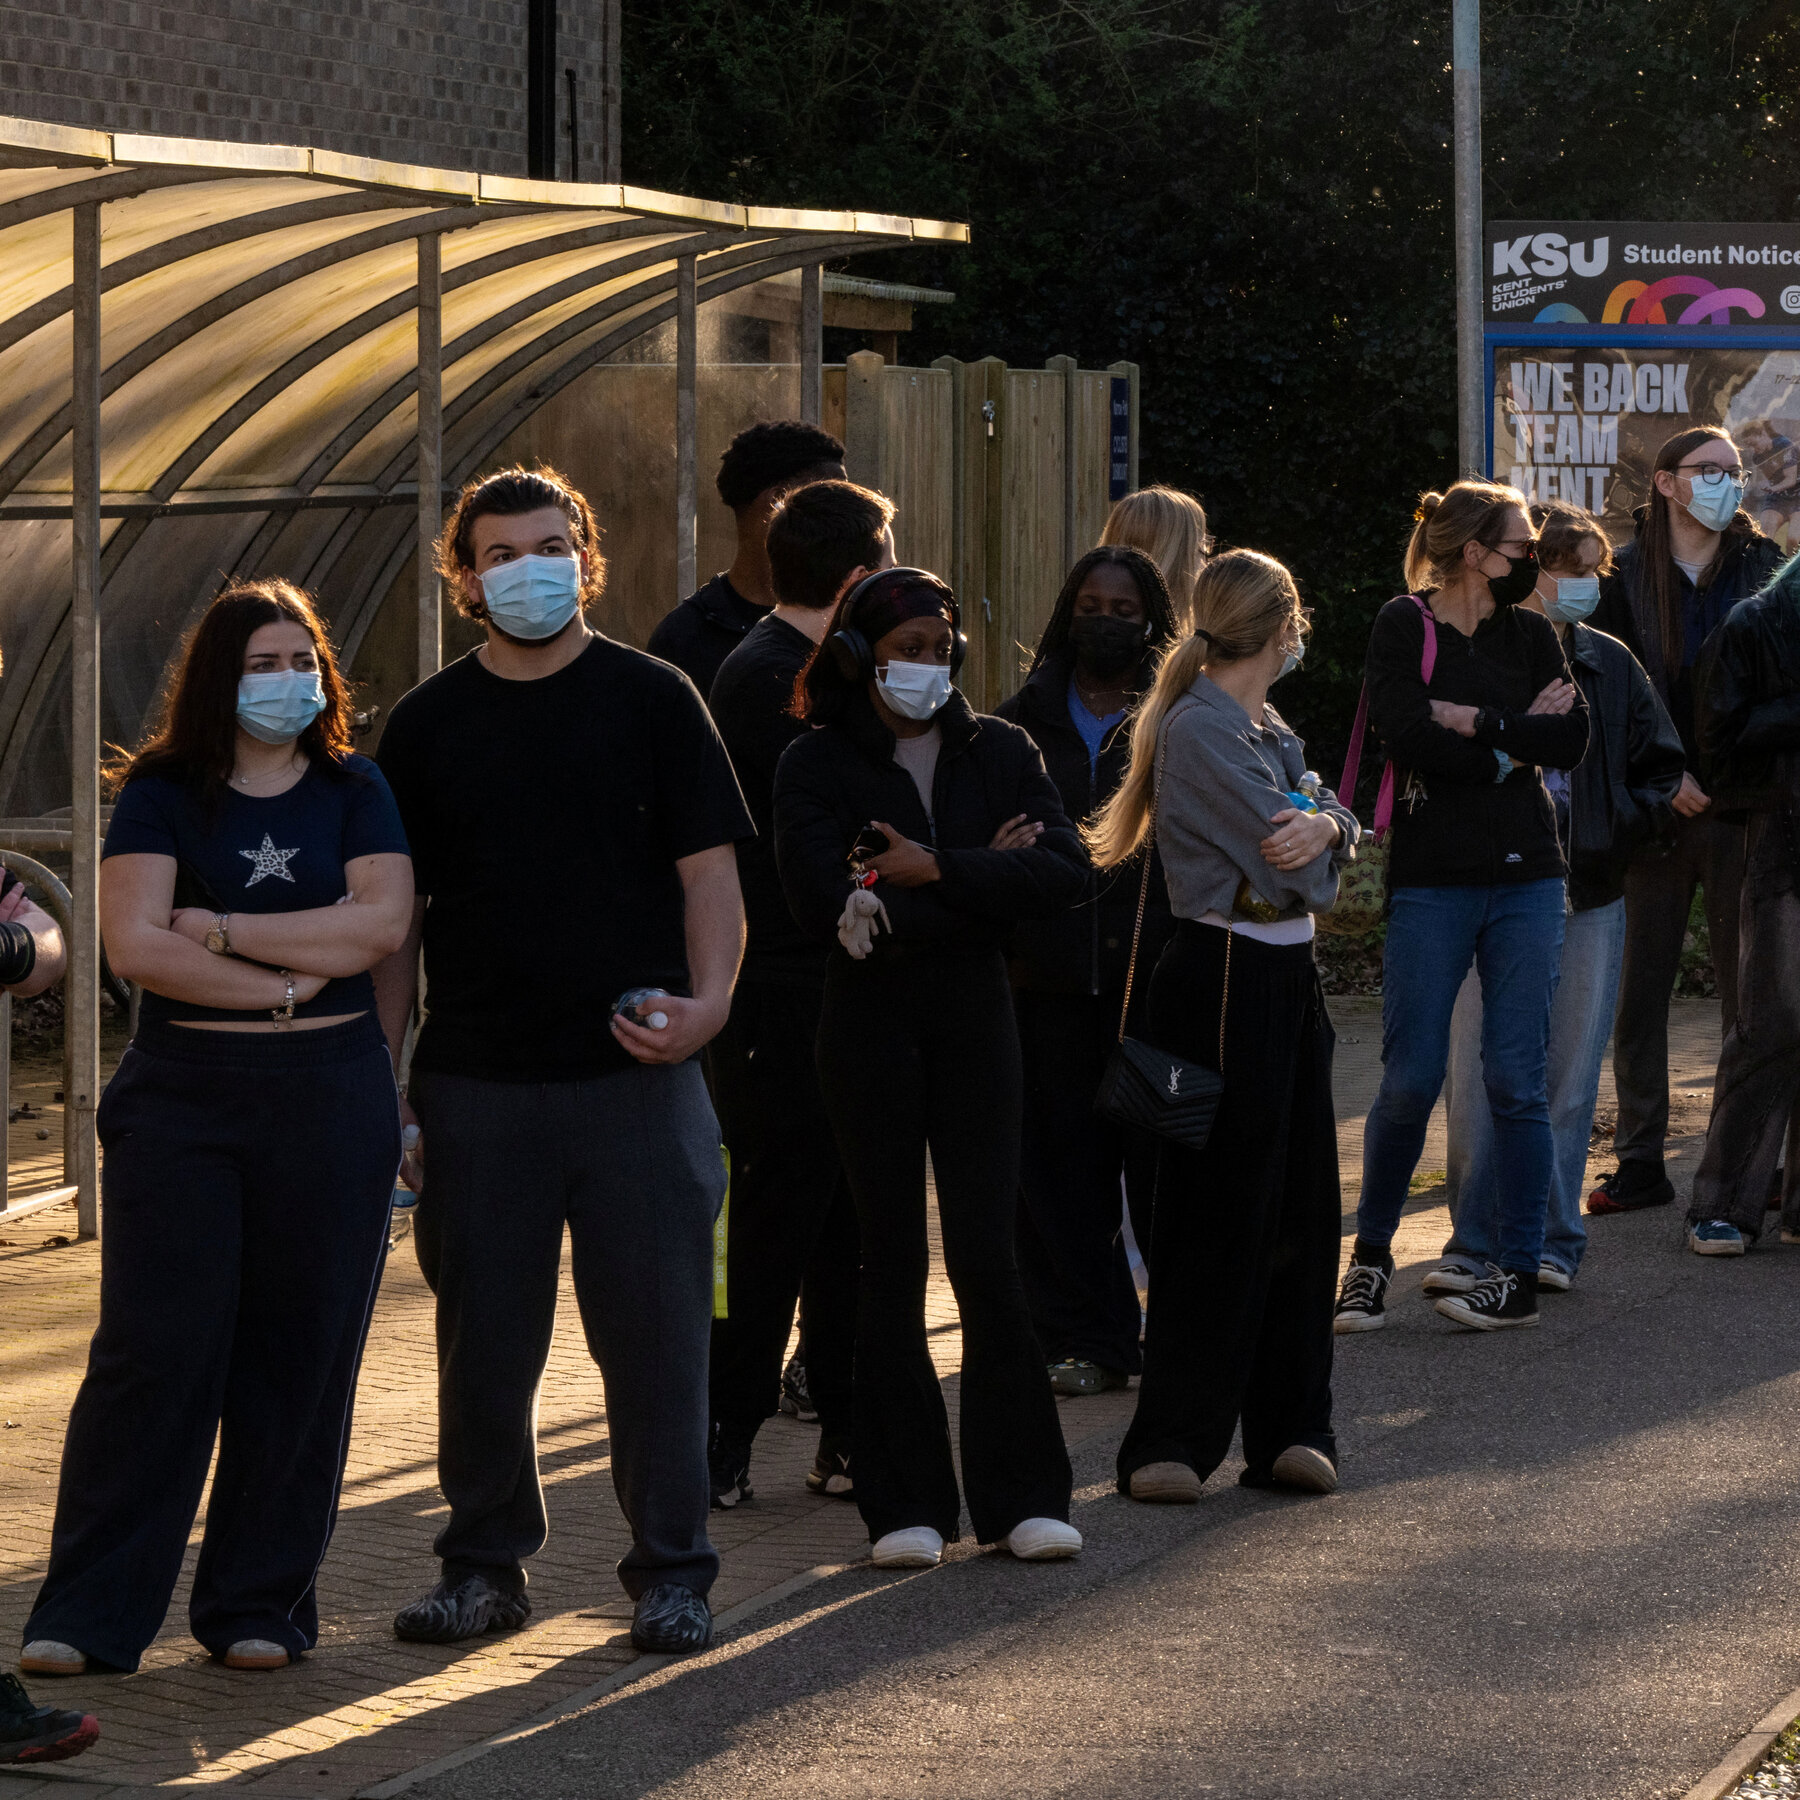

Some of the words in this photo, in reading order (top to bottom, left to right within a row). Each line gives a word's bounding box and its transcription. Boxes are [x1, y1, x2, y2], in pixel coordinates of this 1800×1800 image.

[1493, 233, 1609, 277] KSU
[1623, 244, 1722, 264] Student
[1492, 278, 1532, 294] KENT
[1492, 296, 1535, 312] UNION
[1510, 362, 1574, 412] WE
[1583, 363, 1690, 413] BACK
[1510, 414, 1619, 464] TEAM
[1510, 466, 1610, 516] KENT
[716, 1239, 725, 1285] COLLEGE
